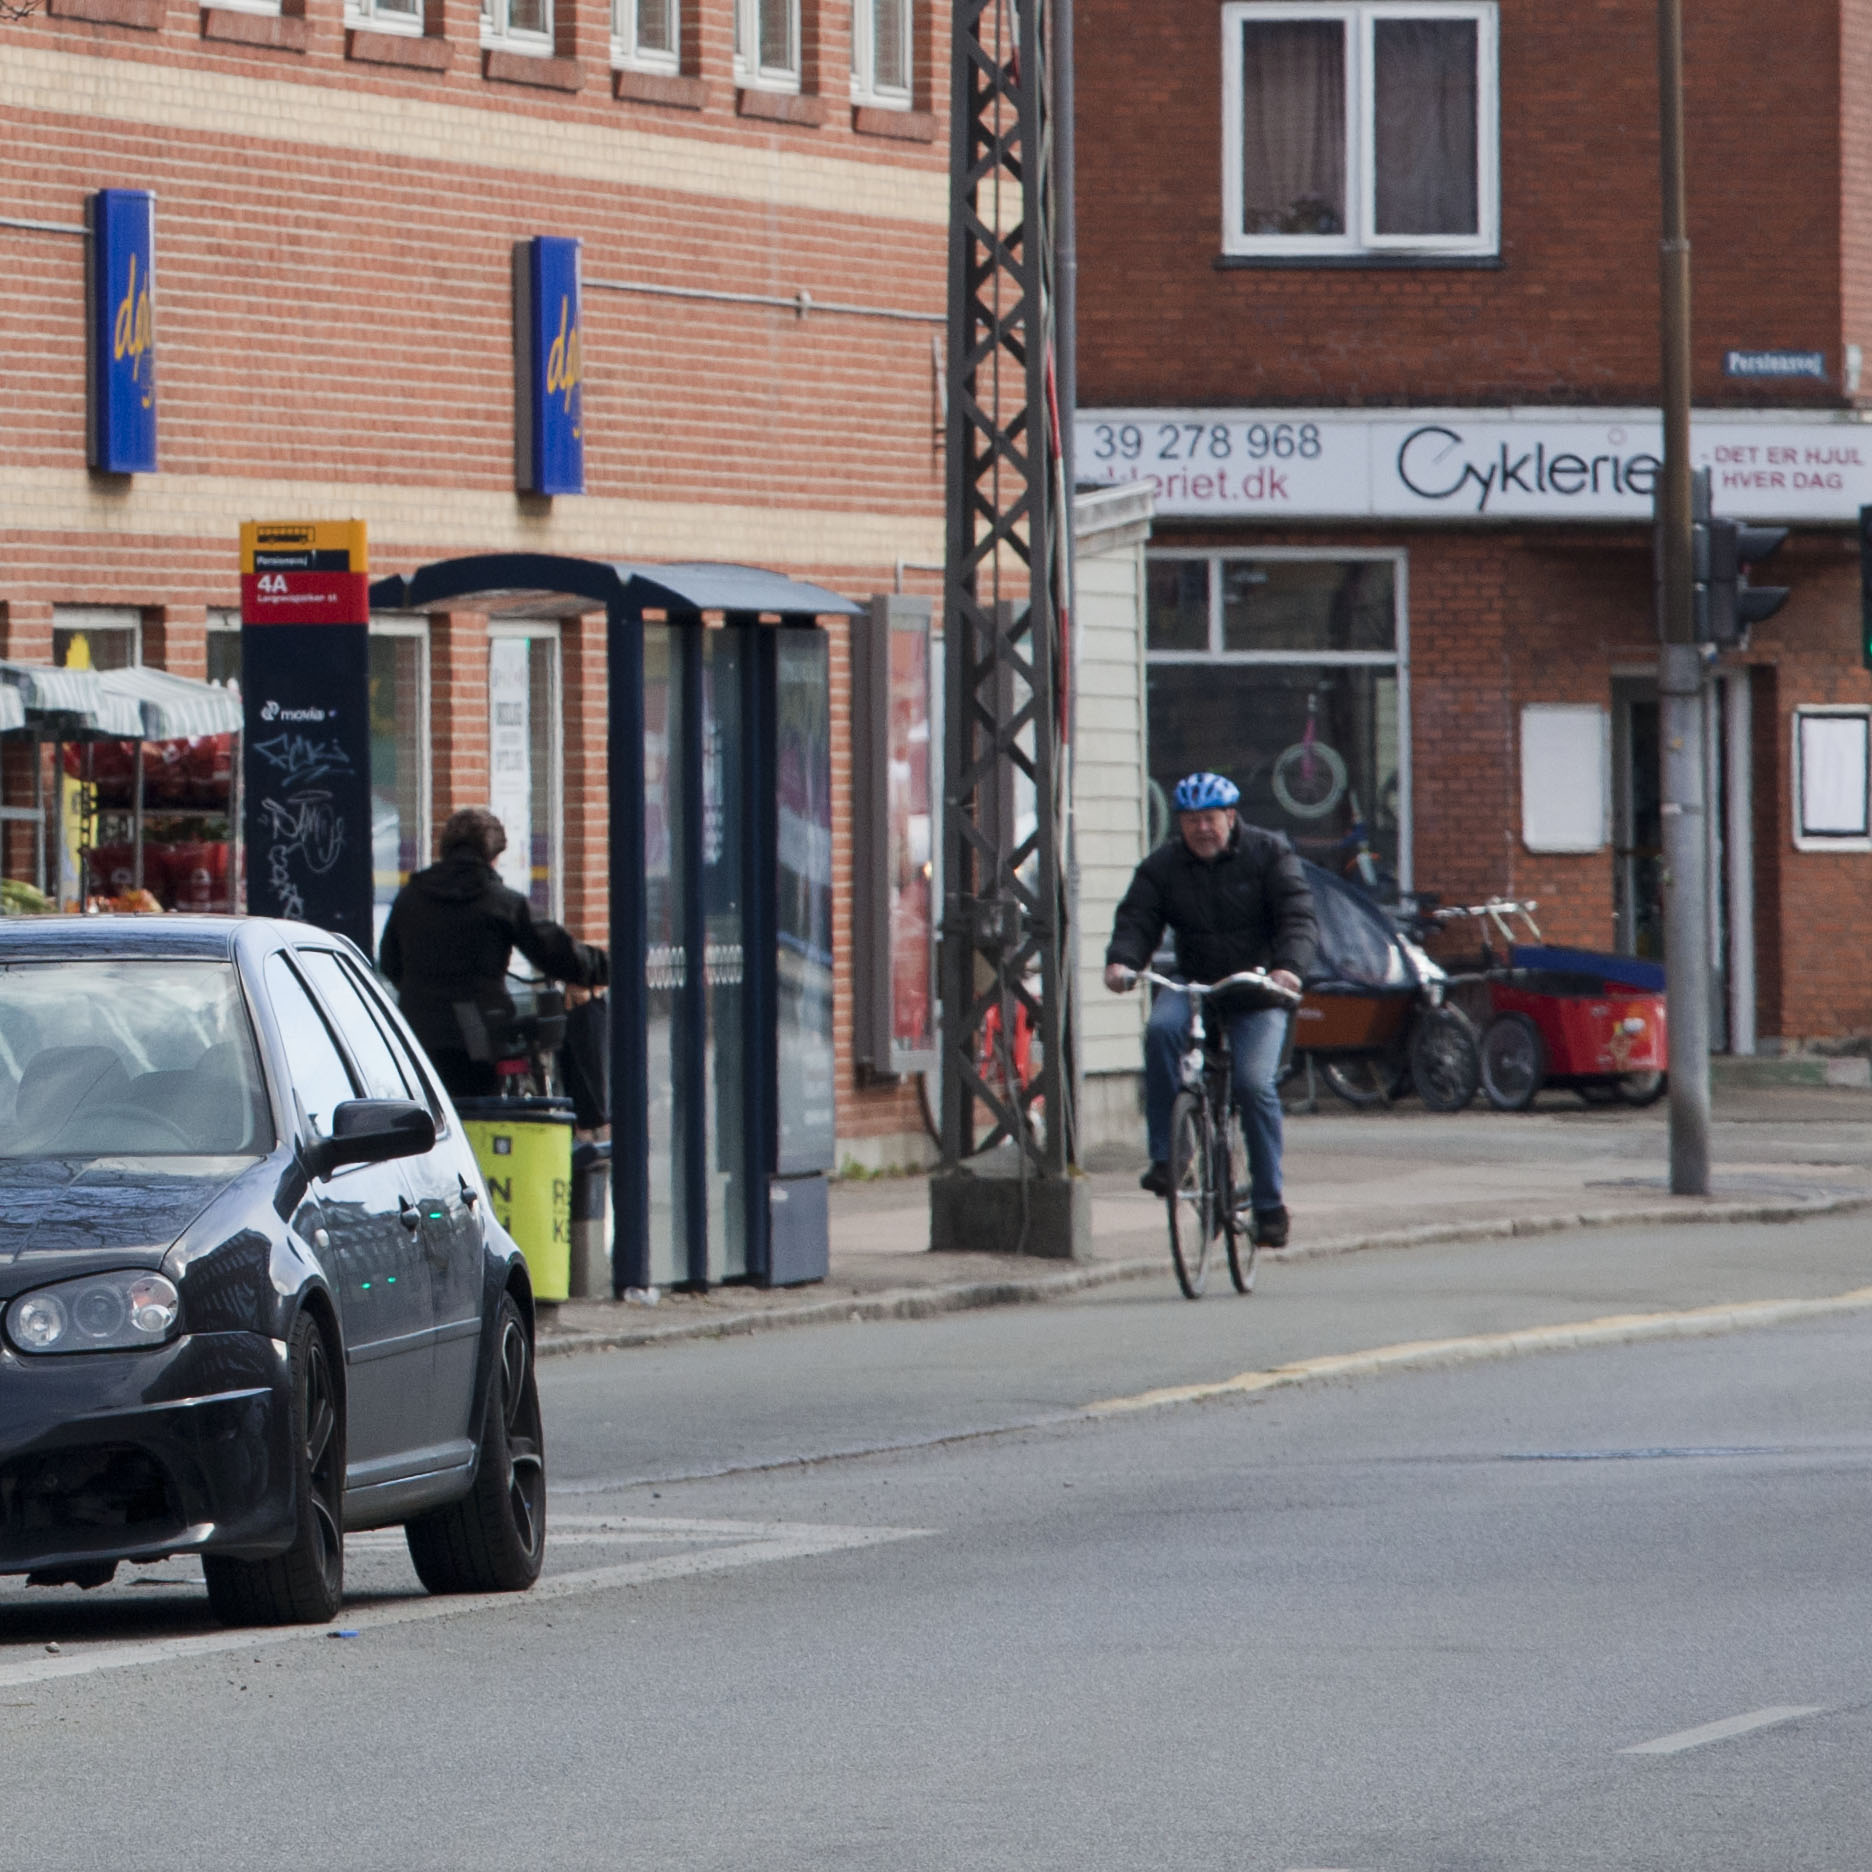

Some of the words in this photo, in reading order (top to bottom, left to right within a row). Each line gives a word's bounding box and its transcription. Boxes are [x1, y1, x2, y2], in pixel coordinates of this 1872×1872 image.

[1094, 424, 1143, 460] 39
[1158, 424, 1232, 460] 278
[1248, 423, 1323, 460] 968
[1715, 446, 1759, 463] DET
[1767, 446, 1798, 464] ER
[1806, 447, 1864, 465] HJUL
[1398, 425, 1664, 512] Cyklerie
[1723, 471, 1786, 488] HVER
[1793, 472, 1843, 489] DAG
[257, 573, 288, 594] 4A
[280, 707, 326, 721] movia
